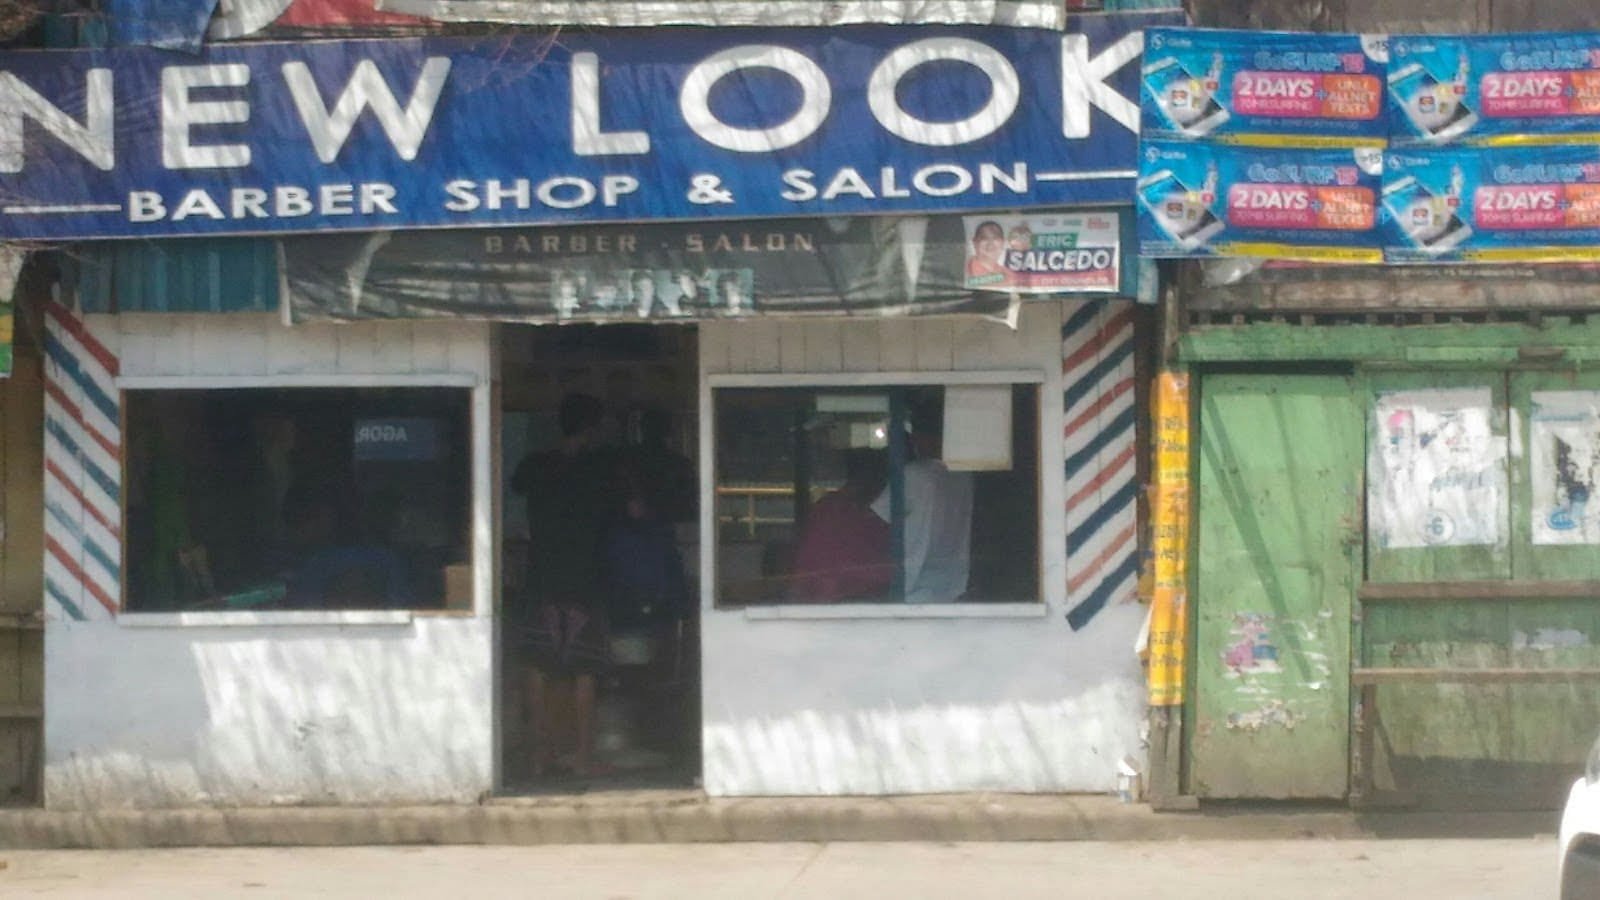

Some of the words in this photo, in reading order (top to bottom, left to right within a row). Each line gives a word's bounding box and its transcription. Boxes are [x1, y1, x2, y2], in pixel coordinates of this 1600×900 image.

[1238, 78, 1253, 97] 2
[1254, 78, 1314, 98] DAYS
[1487, 78, 1501, 97] 2
[1503, 77, 1563, 97] DAYS
[0, 57, 451, 174] NEW
[571, 30, 1144, 156] LOOK
[129, 182, 399, 222] BARBER
[445, 174, 639, 212] SHOP
[688, 174, 734, 204] &
[781, 162, 1030, 201] SALON
[1233, 190, 1249, 209] 2
[1250, 190, 1309, 210] DAYS
[1496, 190, 1557, 211] DAYS
[484, 235, 638, 253] BARBER
[685, 232, 815, 252] SALON
[1037, 234, 1073, 248] ERIC
[1008, 249, 1111, 272] SALCEDO
